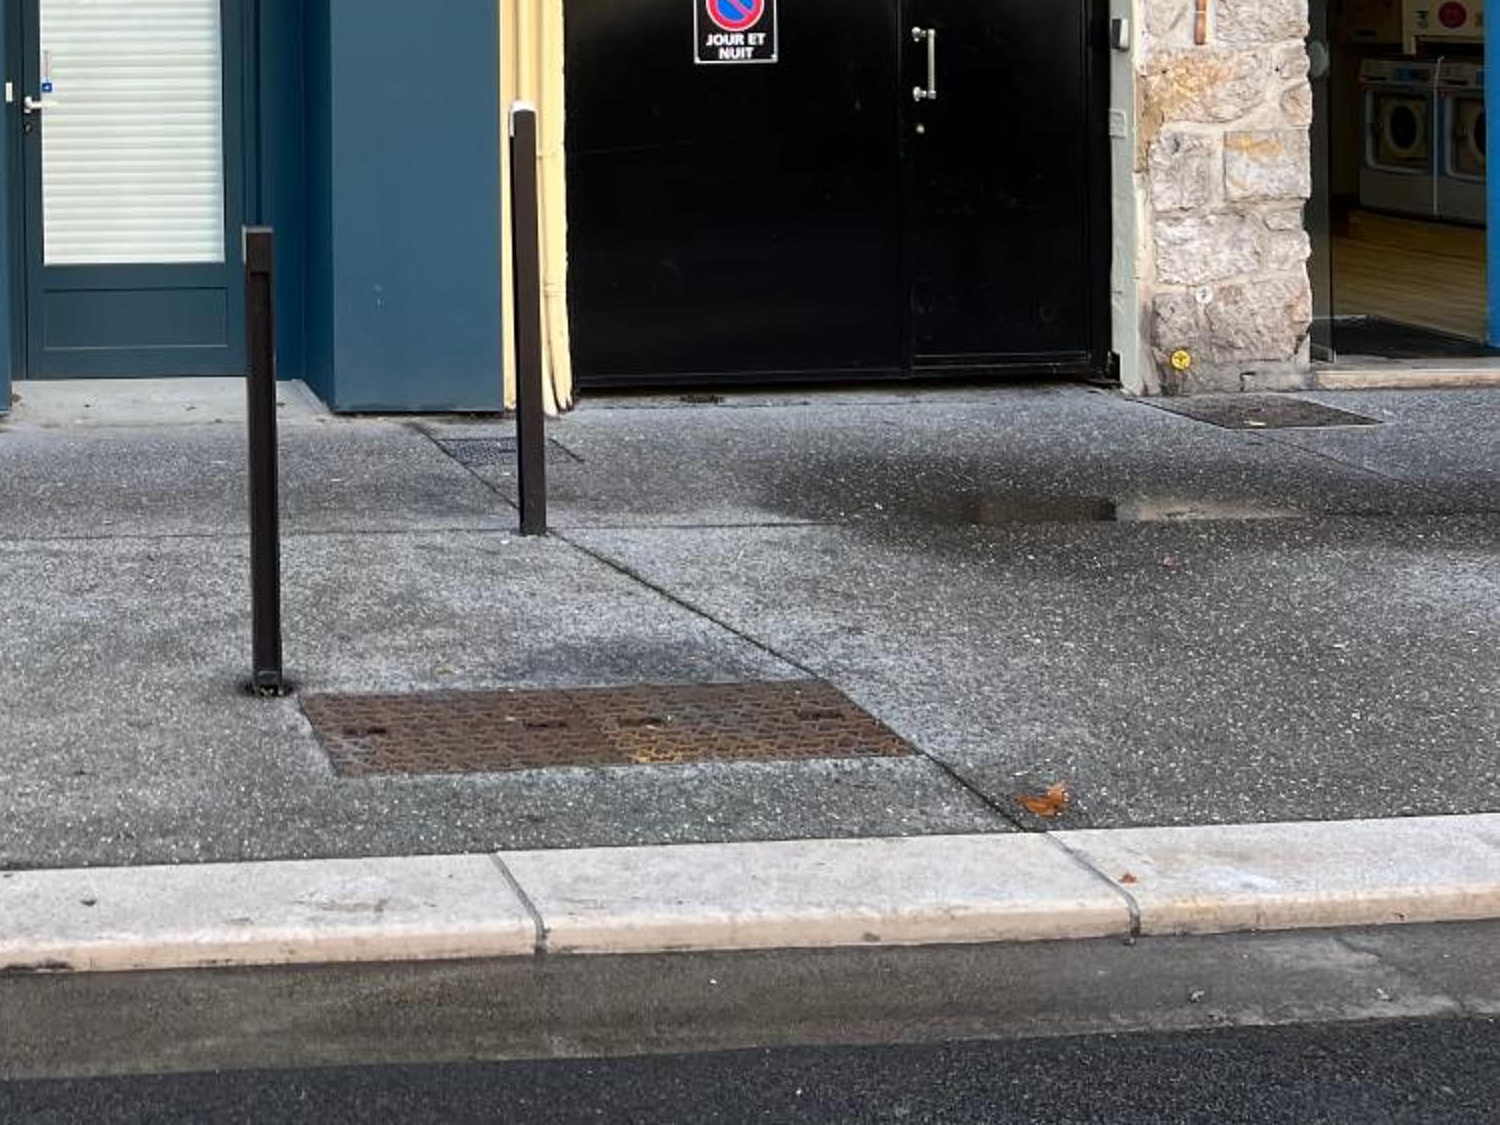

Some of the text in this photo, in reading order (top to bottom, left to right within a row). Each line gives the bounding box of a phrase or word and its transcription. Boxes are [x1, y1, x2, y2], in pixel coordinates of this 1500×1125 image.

[705, 31, 767, 47] JOUR ET
[718, 46, 756, 60] NUIT
